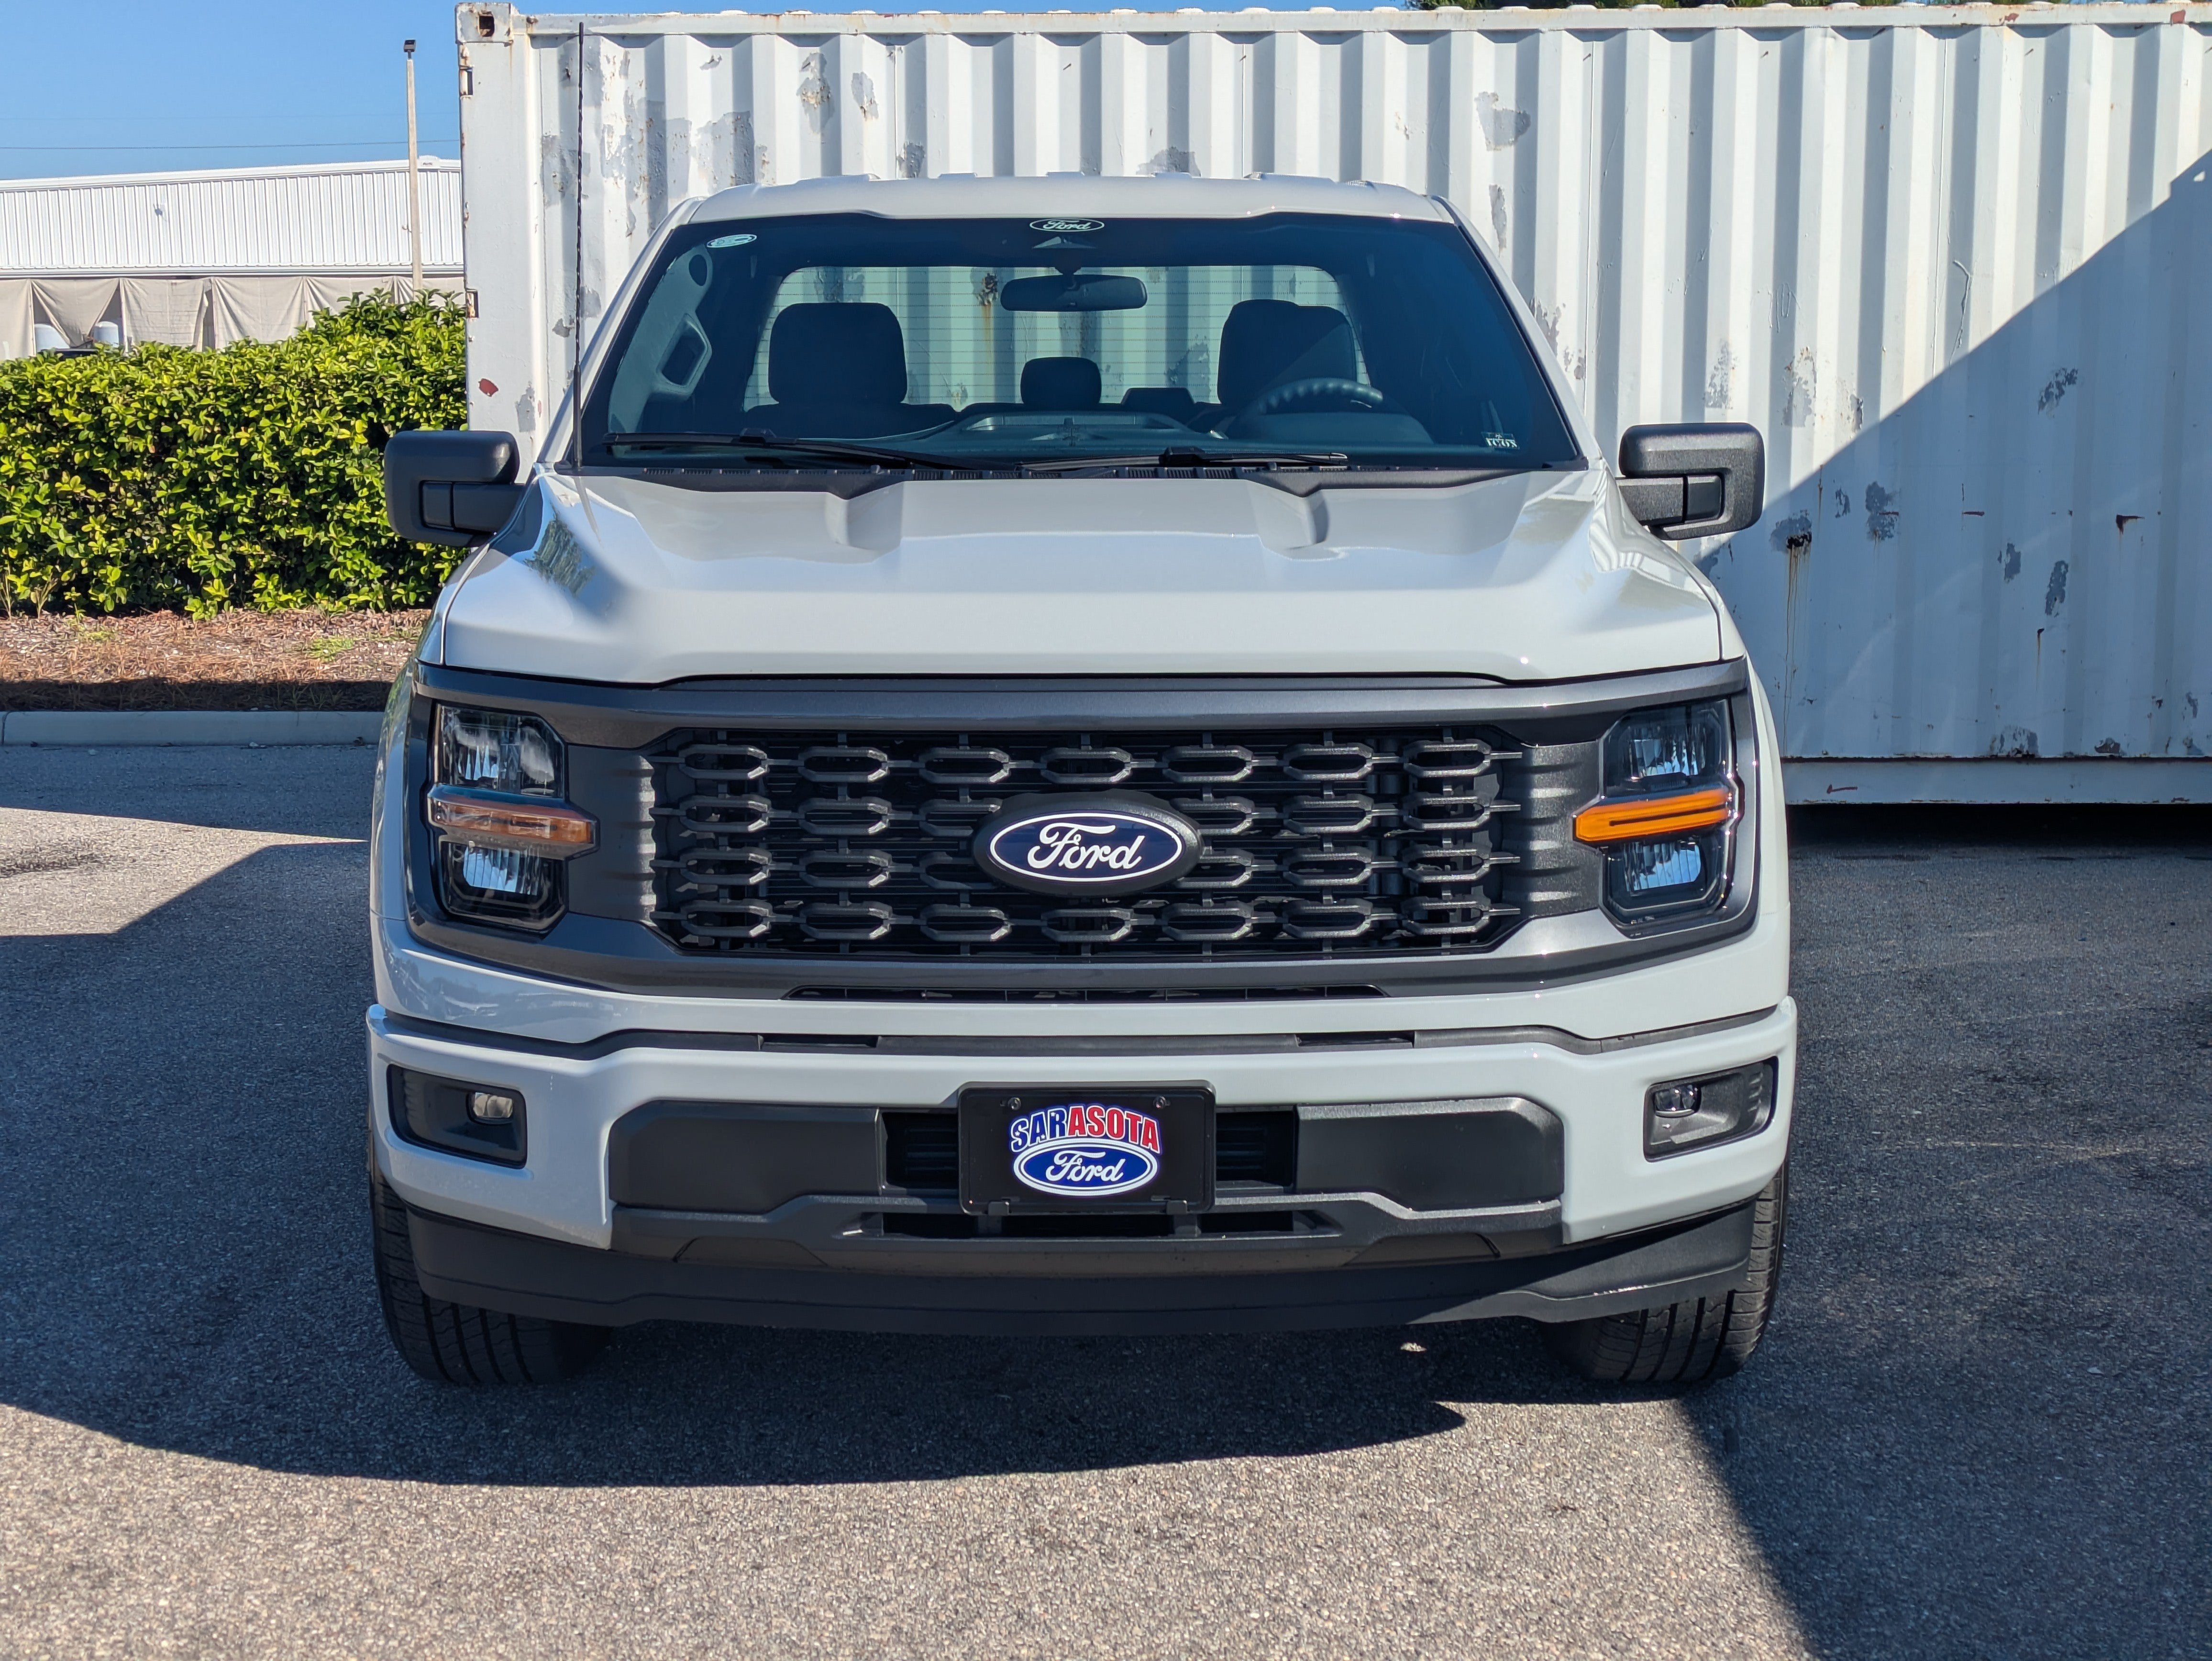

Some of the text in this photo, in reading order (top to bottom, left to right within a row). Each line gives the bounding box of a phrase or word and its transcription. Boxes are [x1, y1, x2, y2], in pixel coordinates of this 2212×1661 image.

[1043, 220, 1092, 230] Ford
[1027, 822, 1145, 869] Ford
[1011, 1105, 1160, 1154] SARASOTA
[1046, 1150, 1126, 1182] Ford
